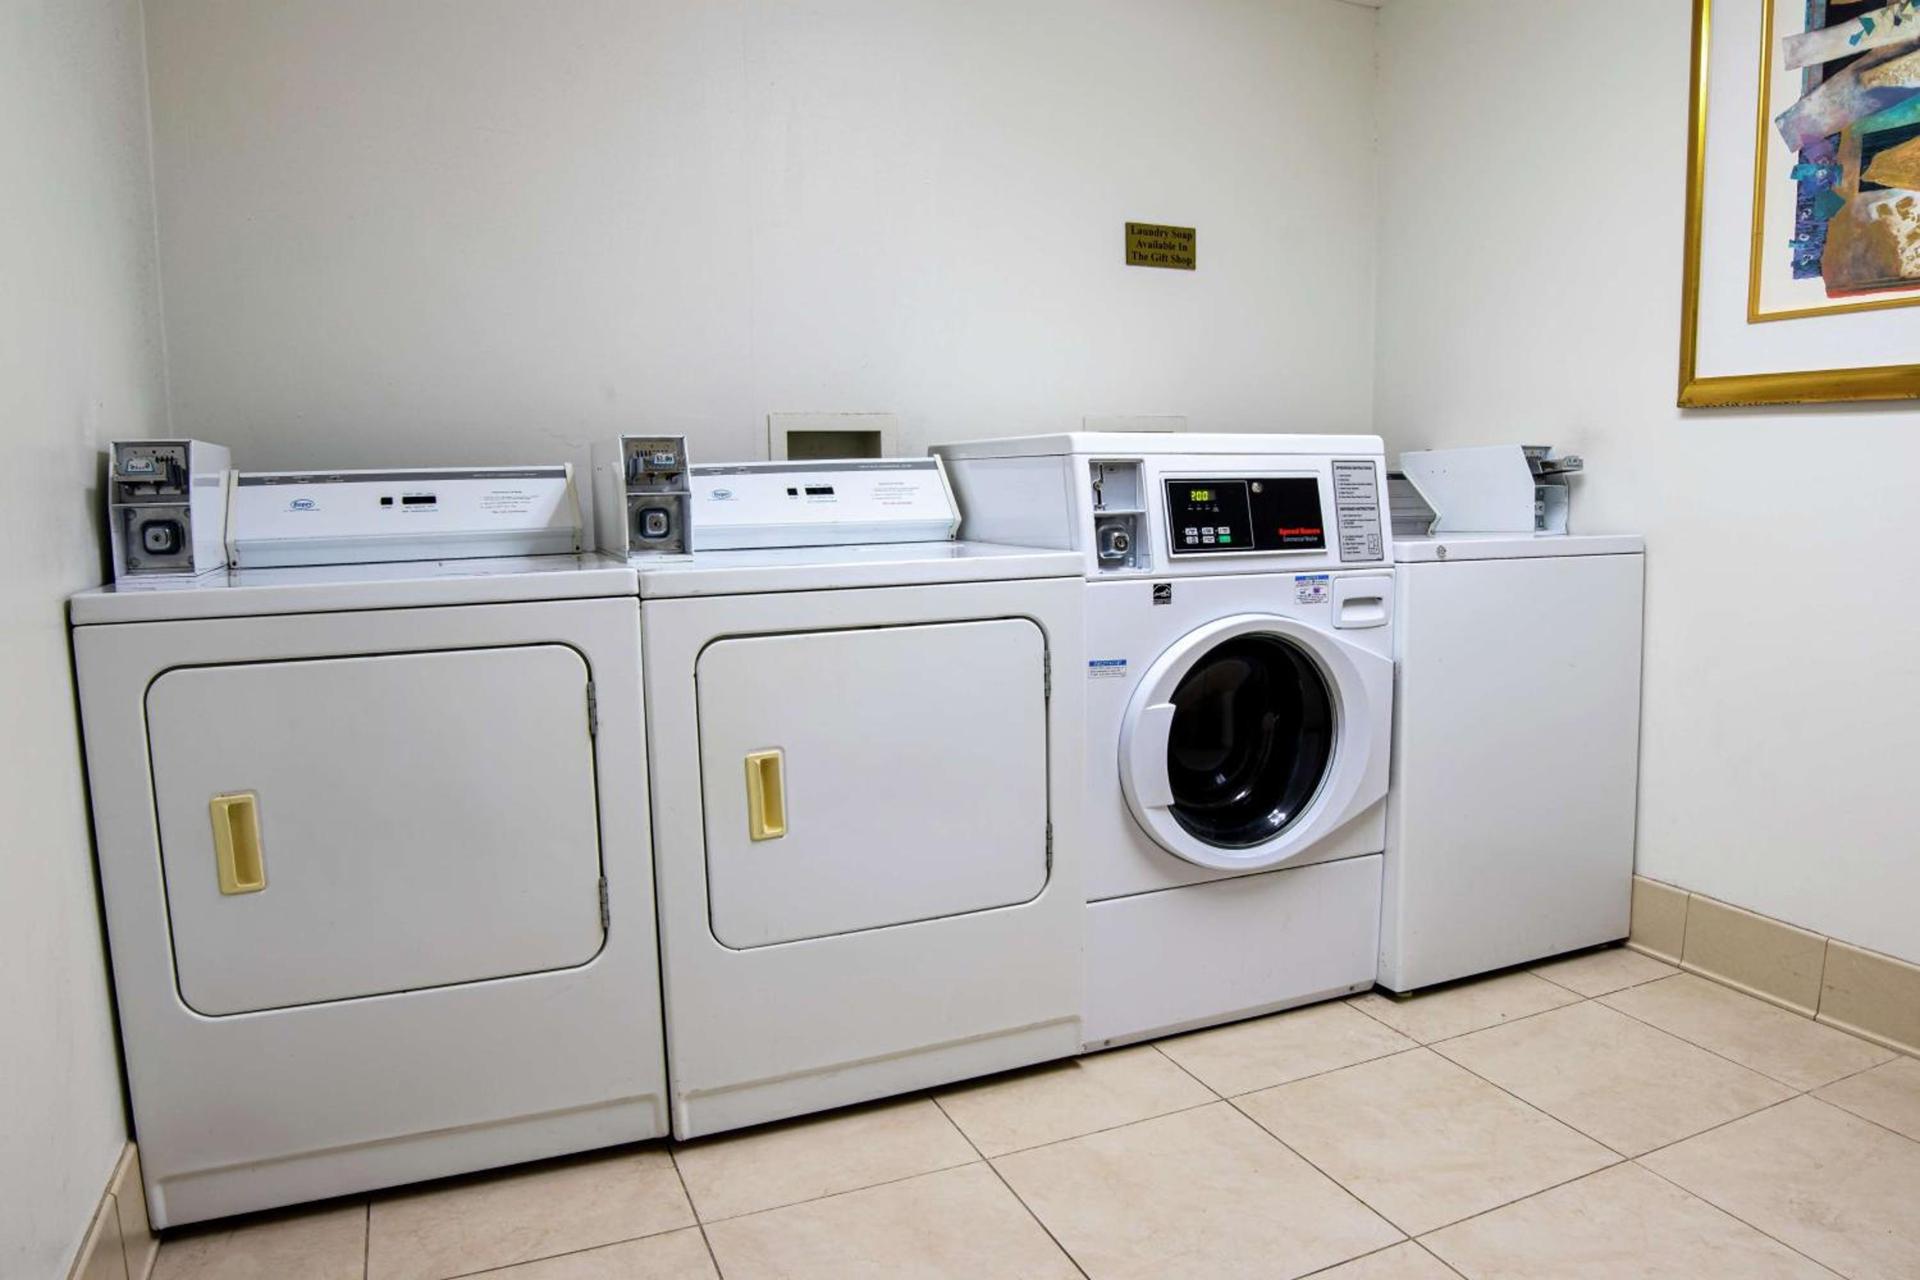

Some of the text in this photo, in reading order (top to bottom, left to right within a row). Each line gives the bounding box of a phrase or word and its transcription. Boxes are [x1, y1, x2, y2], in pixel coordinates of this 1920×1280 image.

[1130, 225, 1193, 241] Laundry Soap
[1136, 239, 1189, 252] Available In
[1132, 249, 1193, 267] The Gift Shop
